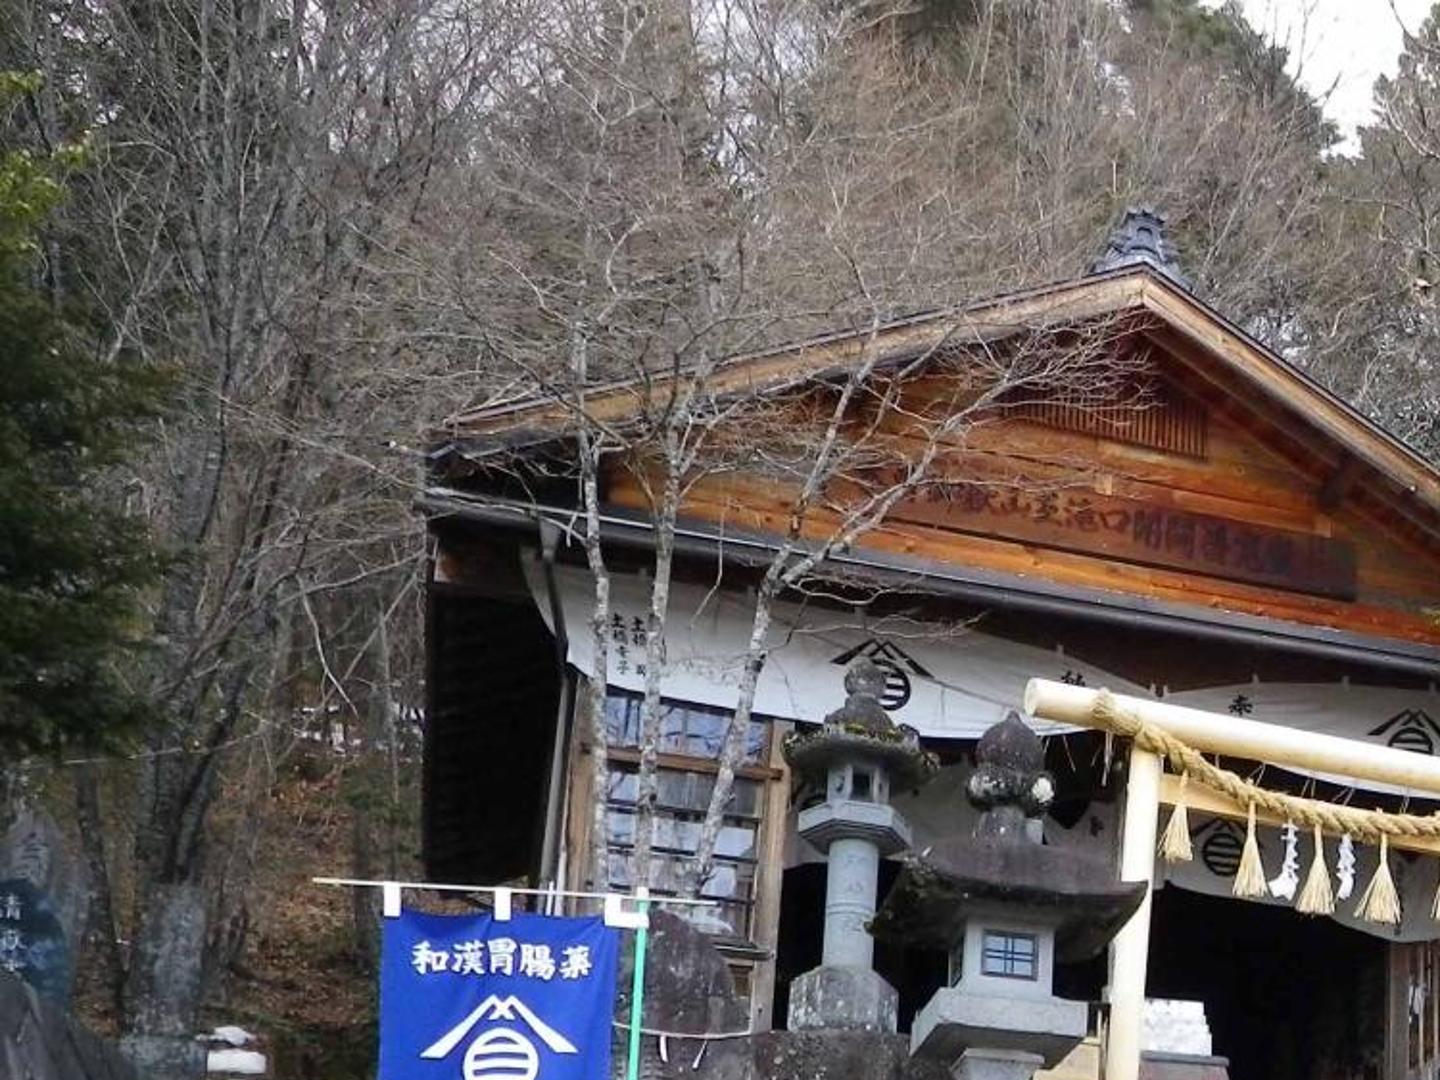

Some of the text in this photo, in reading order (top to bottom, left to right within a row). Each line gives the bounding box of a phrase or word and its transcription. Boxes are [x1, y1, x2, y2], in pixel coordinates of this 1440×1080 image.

[412, 938, 593, 980] 和漢胃腸薬
